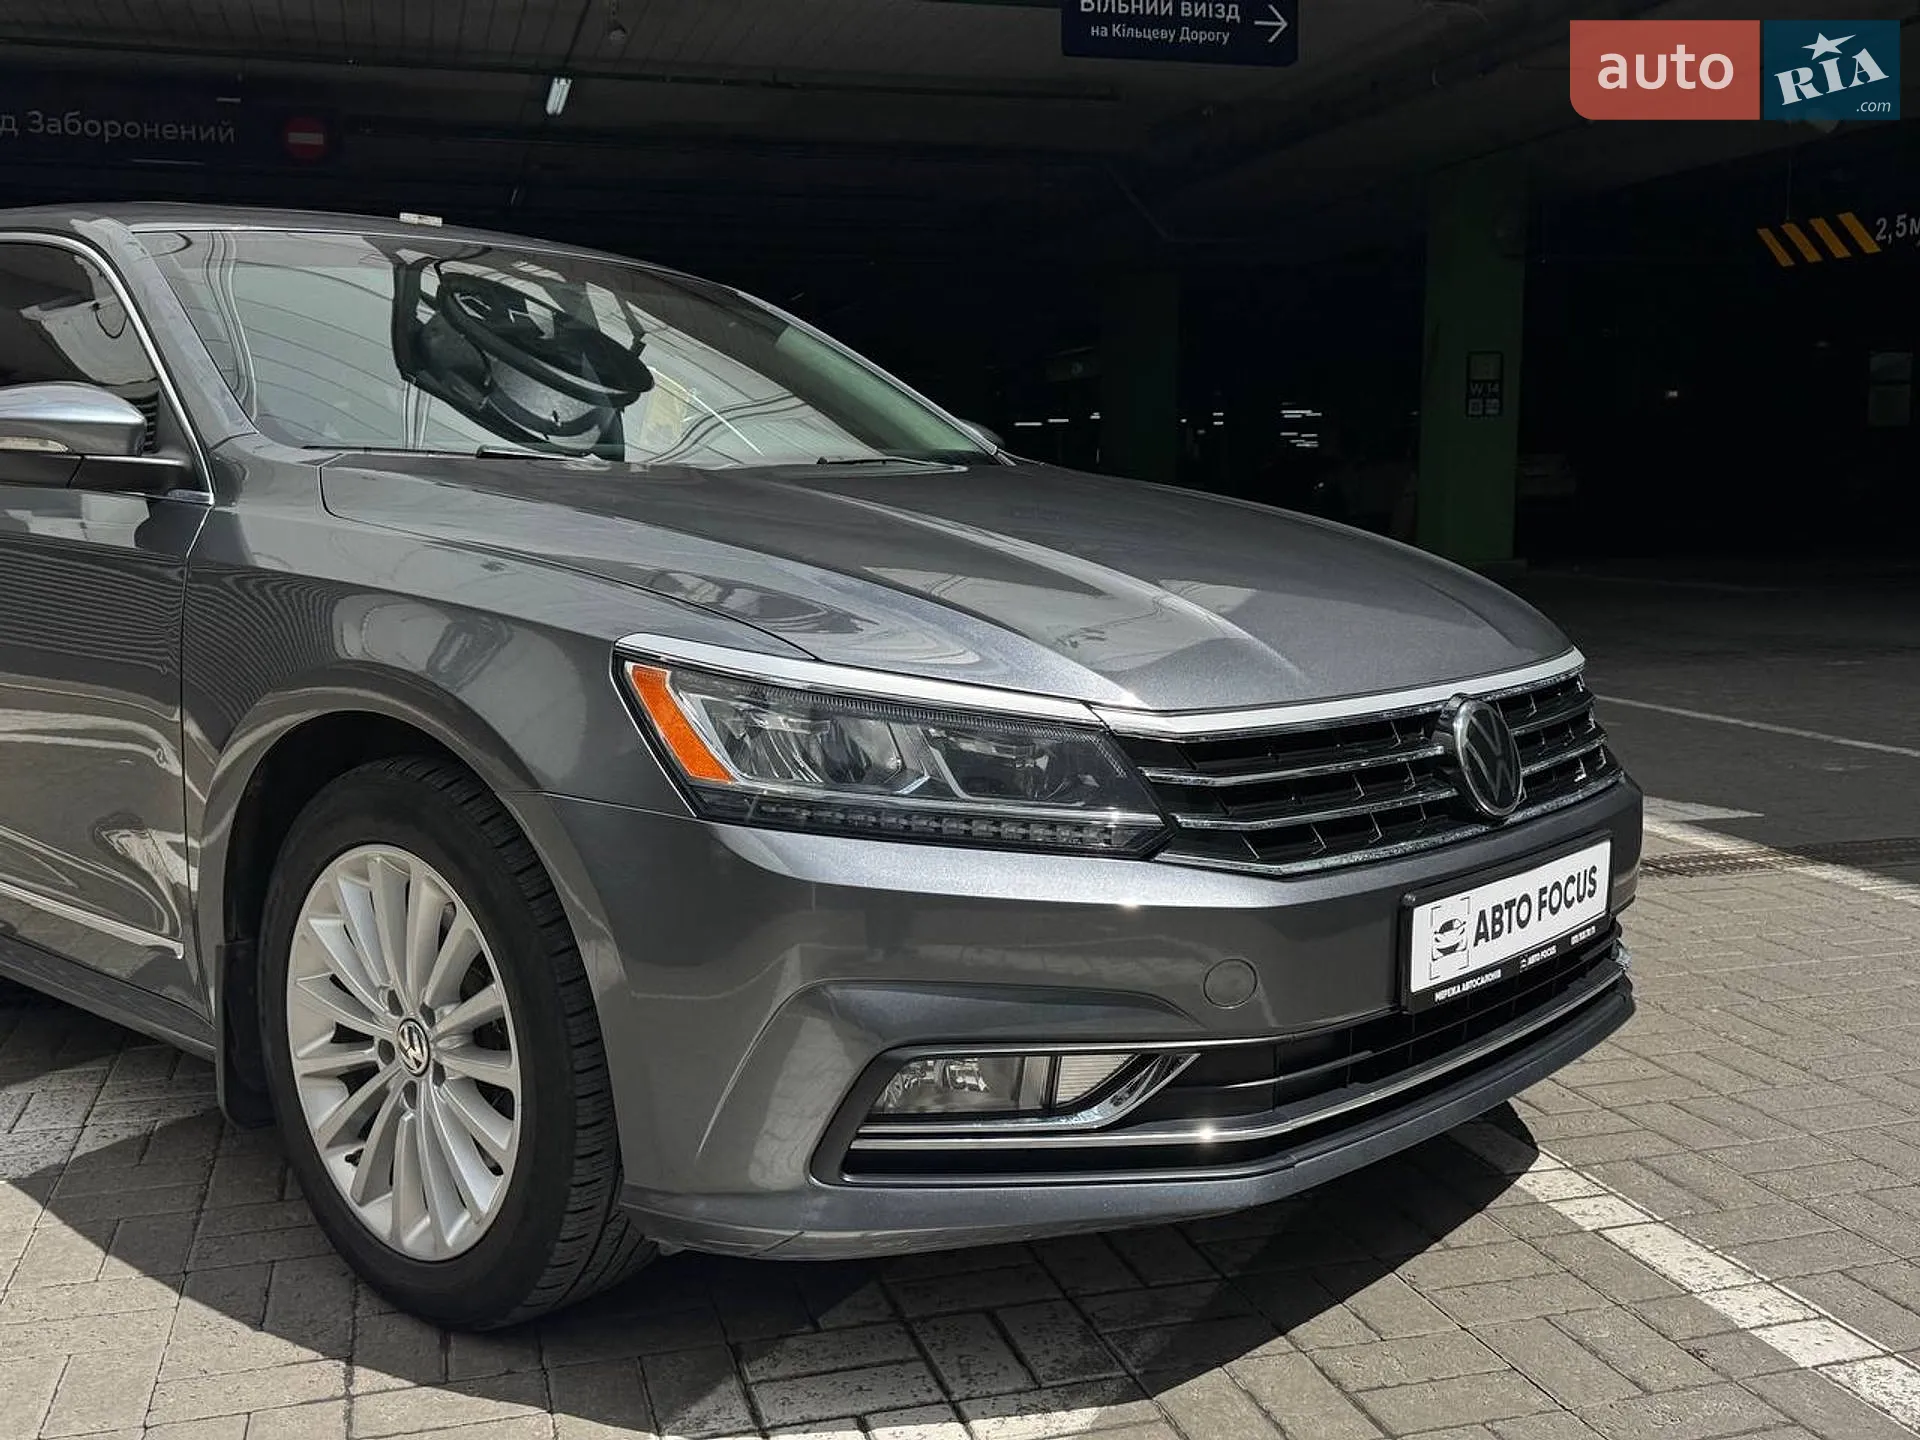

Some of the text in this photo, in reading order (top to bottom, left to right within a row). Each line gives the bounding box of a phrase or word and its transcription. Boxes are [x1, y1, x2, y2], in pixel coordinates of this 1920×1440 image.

[1090, 24, 1230, 45] на Кільцеву Дорогу
[27, 109, 236, 144] Заборонений
[1473, 865, 1598, 947] АВТО FOCUS
